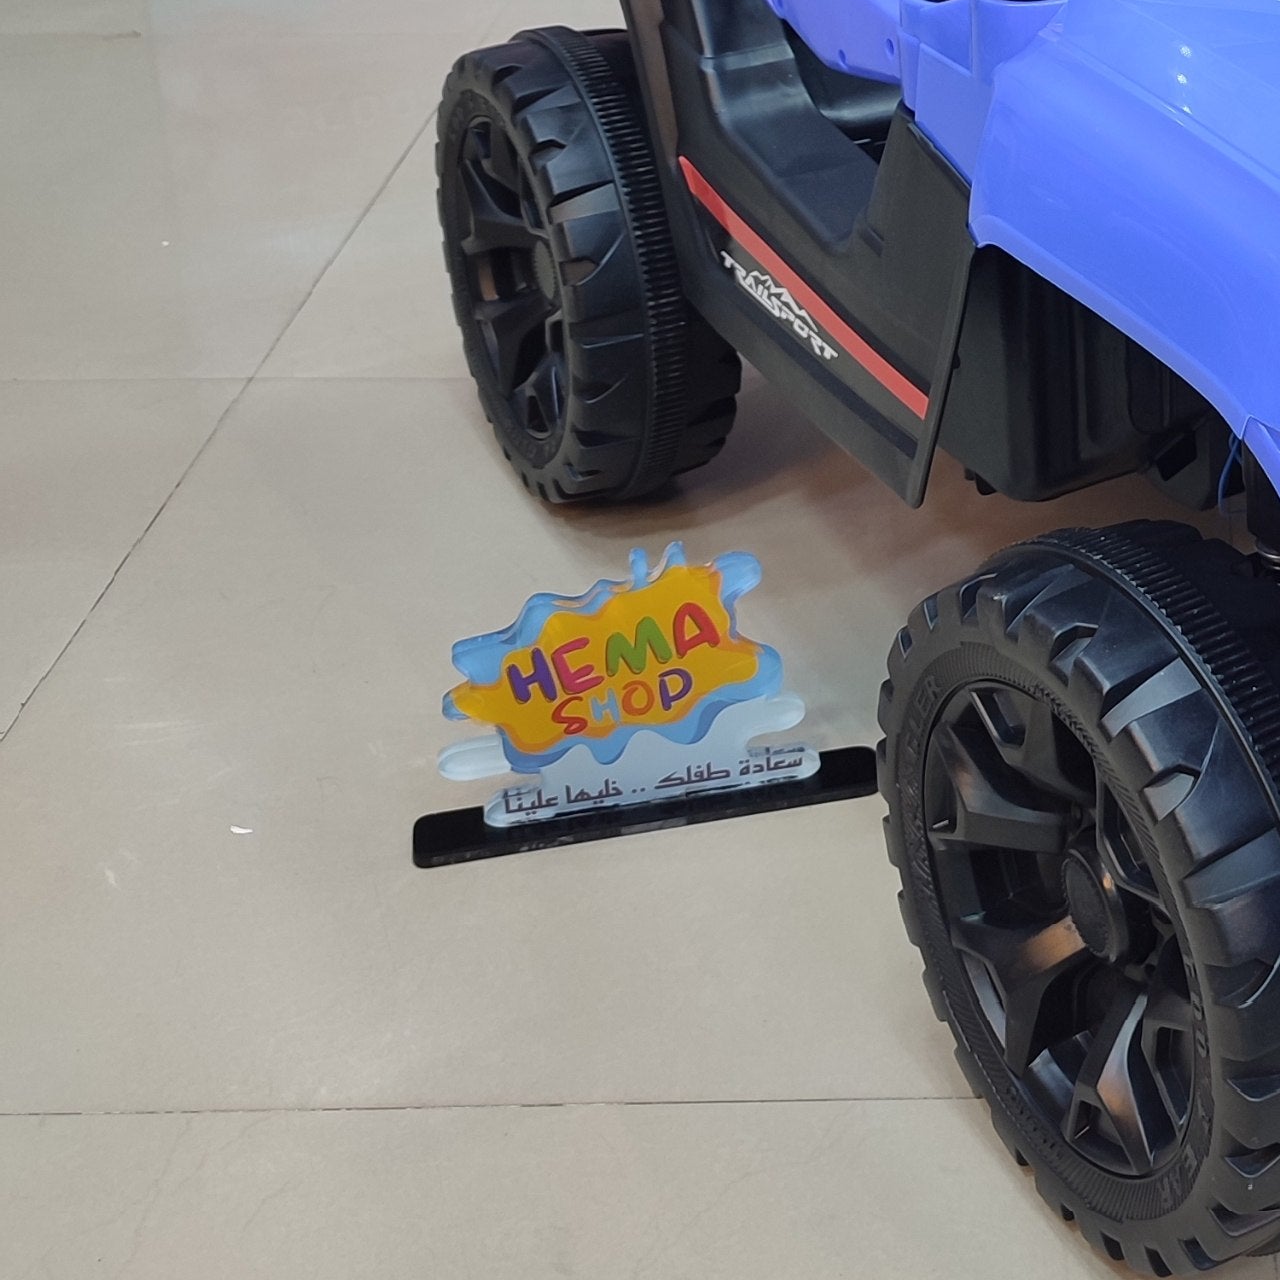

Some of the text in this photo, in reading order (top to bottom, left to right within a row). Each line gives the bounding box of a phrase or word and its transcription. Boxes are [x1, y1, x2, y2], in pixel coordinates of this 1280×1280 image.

[720, 250, 839, 360] TRAILSPORT
[506, 601, 721, 705] HEMA
[551, 667, 693, 736] SHOP
[653, 761, 732, 791] طفلك
[738, 755, 803, 777] سعادة
[503, 788, 560, 817] علينا
[564, 777, 624, 805] خليها
